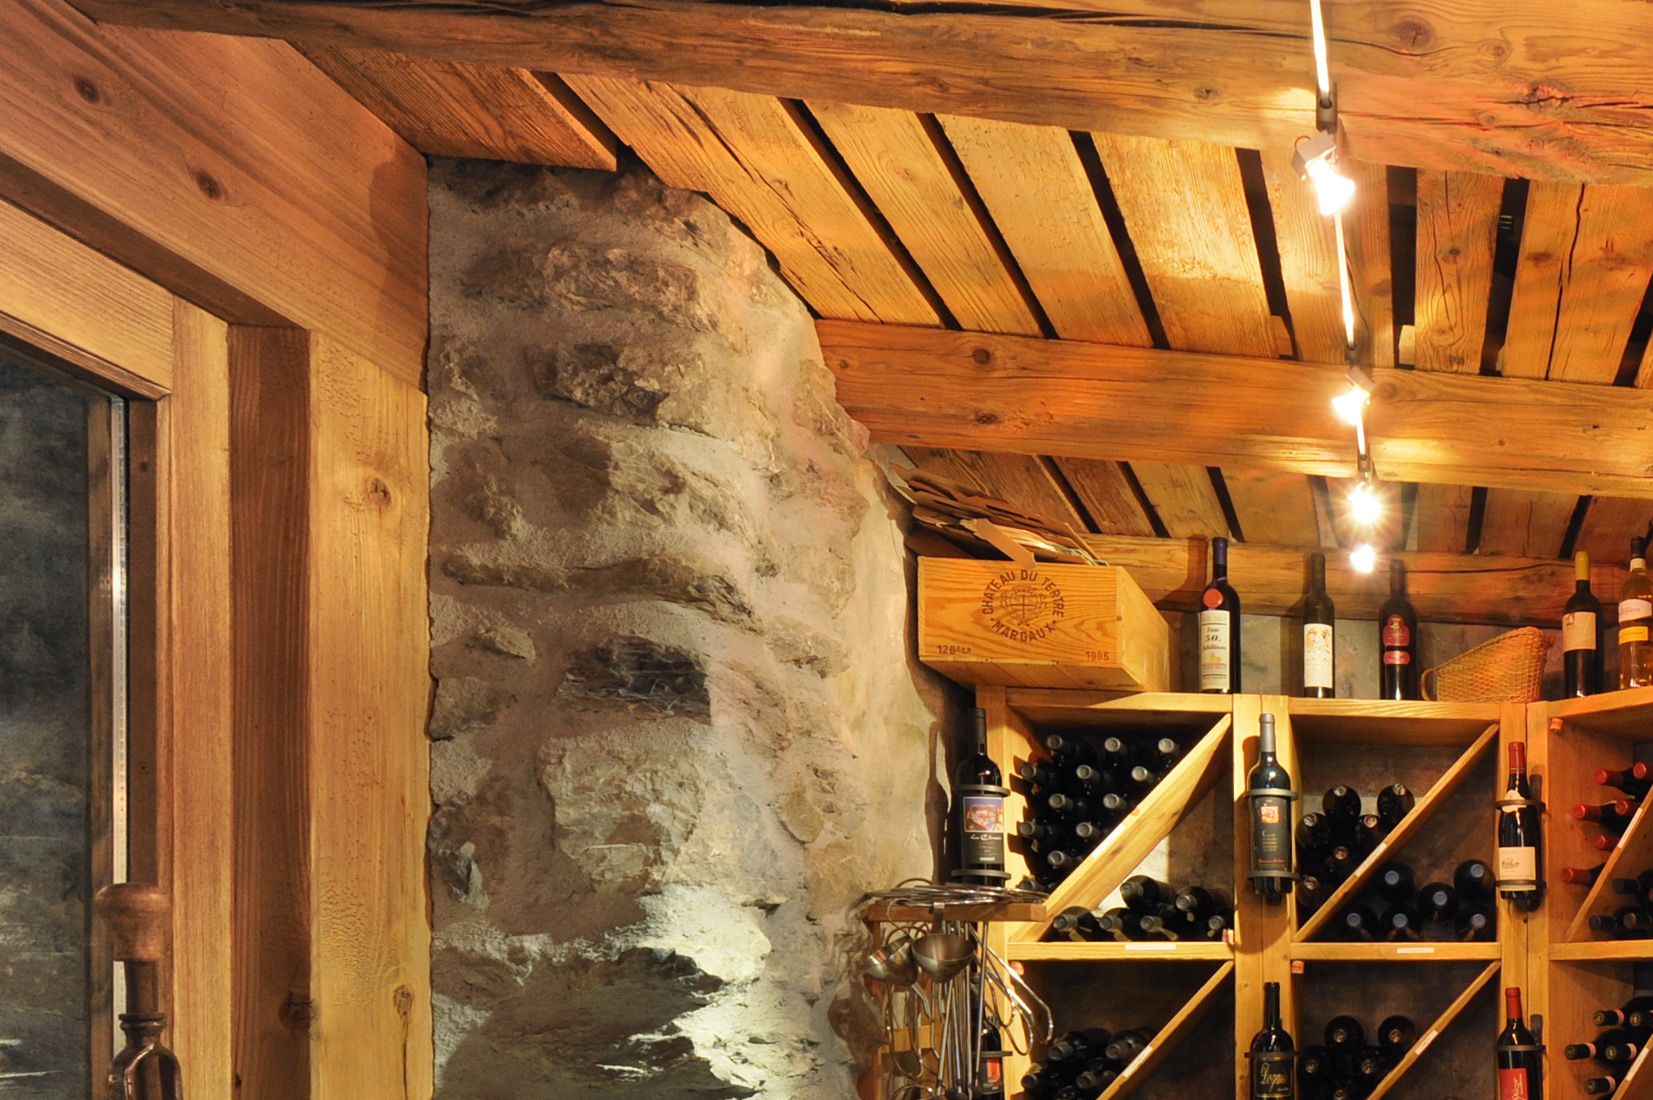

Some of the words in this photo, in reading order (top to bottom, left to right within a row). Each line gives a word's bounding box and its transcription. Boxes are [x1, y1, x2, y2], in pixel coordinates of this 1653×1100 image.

[982, 570, 1016, 615] CHATEAU
[1020, 569, 1039, 582] DU
[1041, 577, 1065, 618] TERTRE
[991, 620, 1057, 642] MARGAUX
